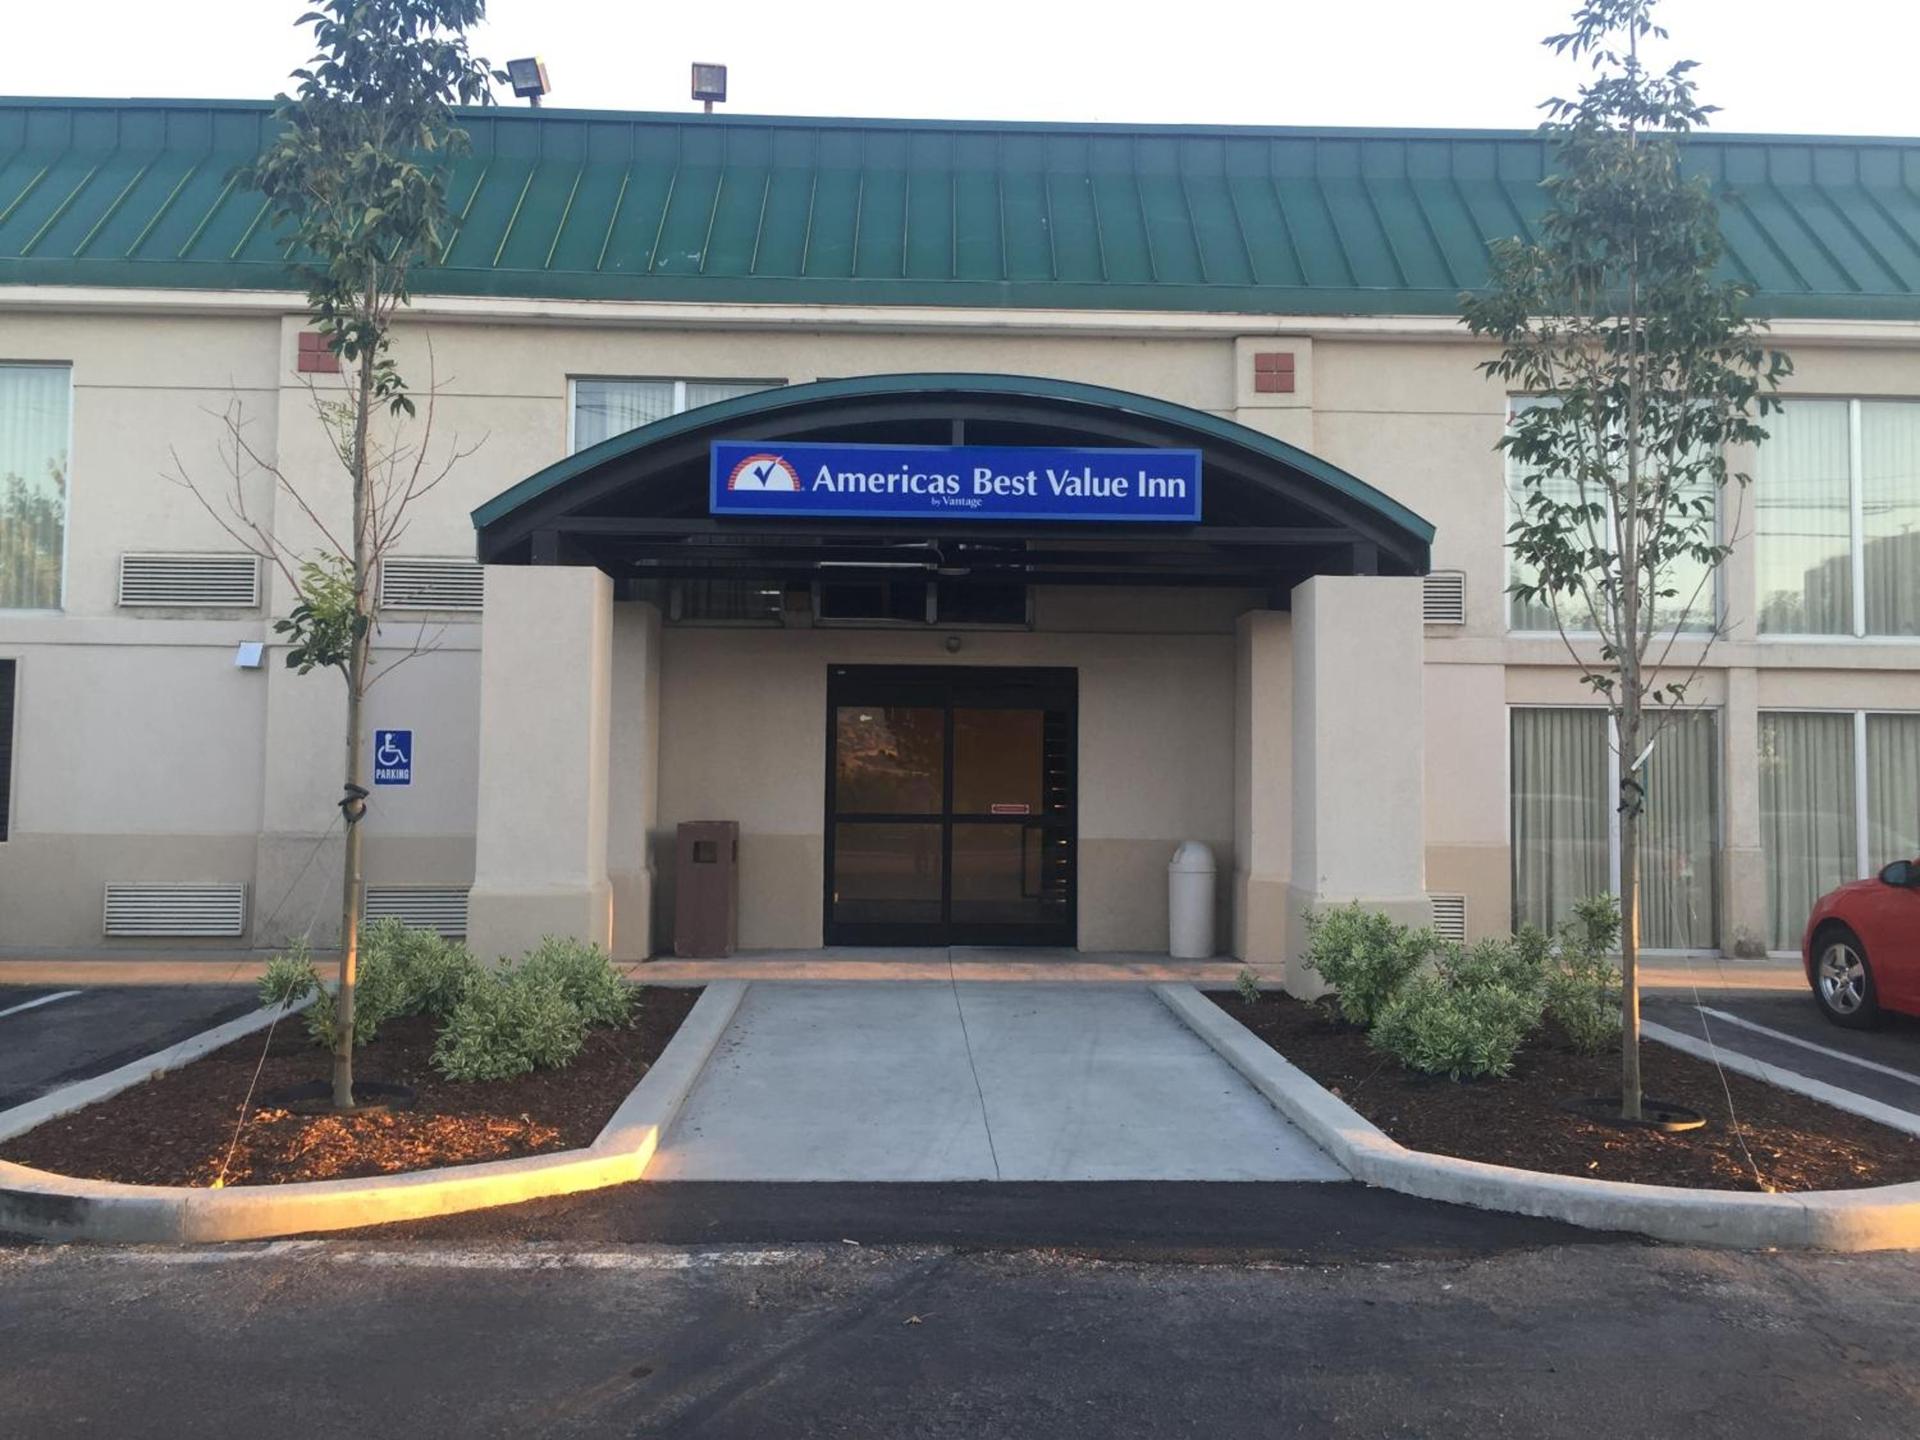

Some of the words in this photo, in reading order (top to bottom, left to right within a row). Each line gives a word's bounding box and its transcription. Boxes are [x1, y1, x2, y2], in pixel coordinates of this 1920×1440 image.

[811, 464, 960, 495] Americas
[973, 467, 1038, 496] Best
[1045, 467, 1129, 497] Value
[1138, 470, 1186, 498] Inn
[931, 497, 941, 507] by
[943, 497, 983, 508] Vantage
[376, 769, 409, 780] PARKING
